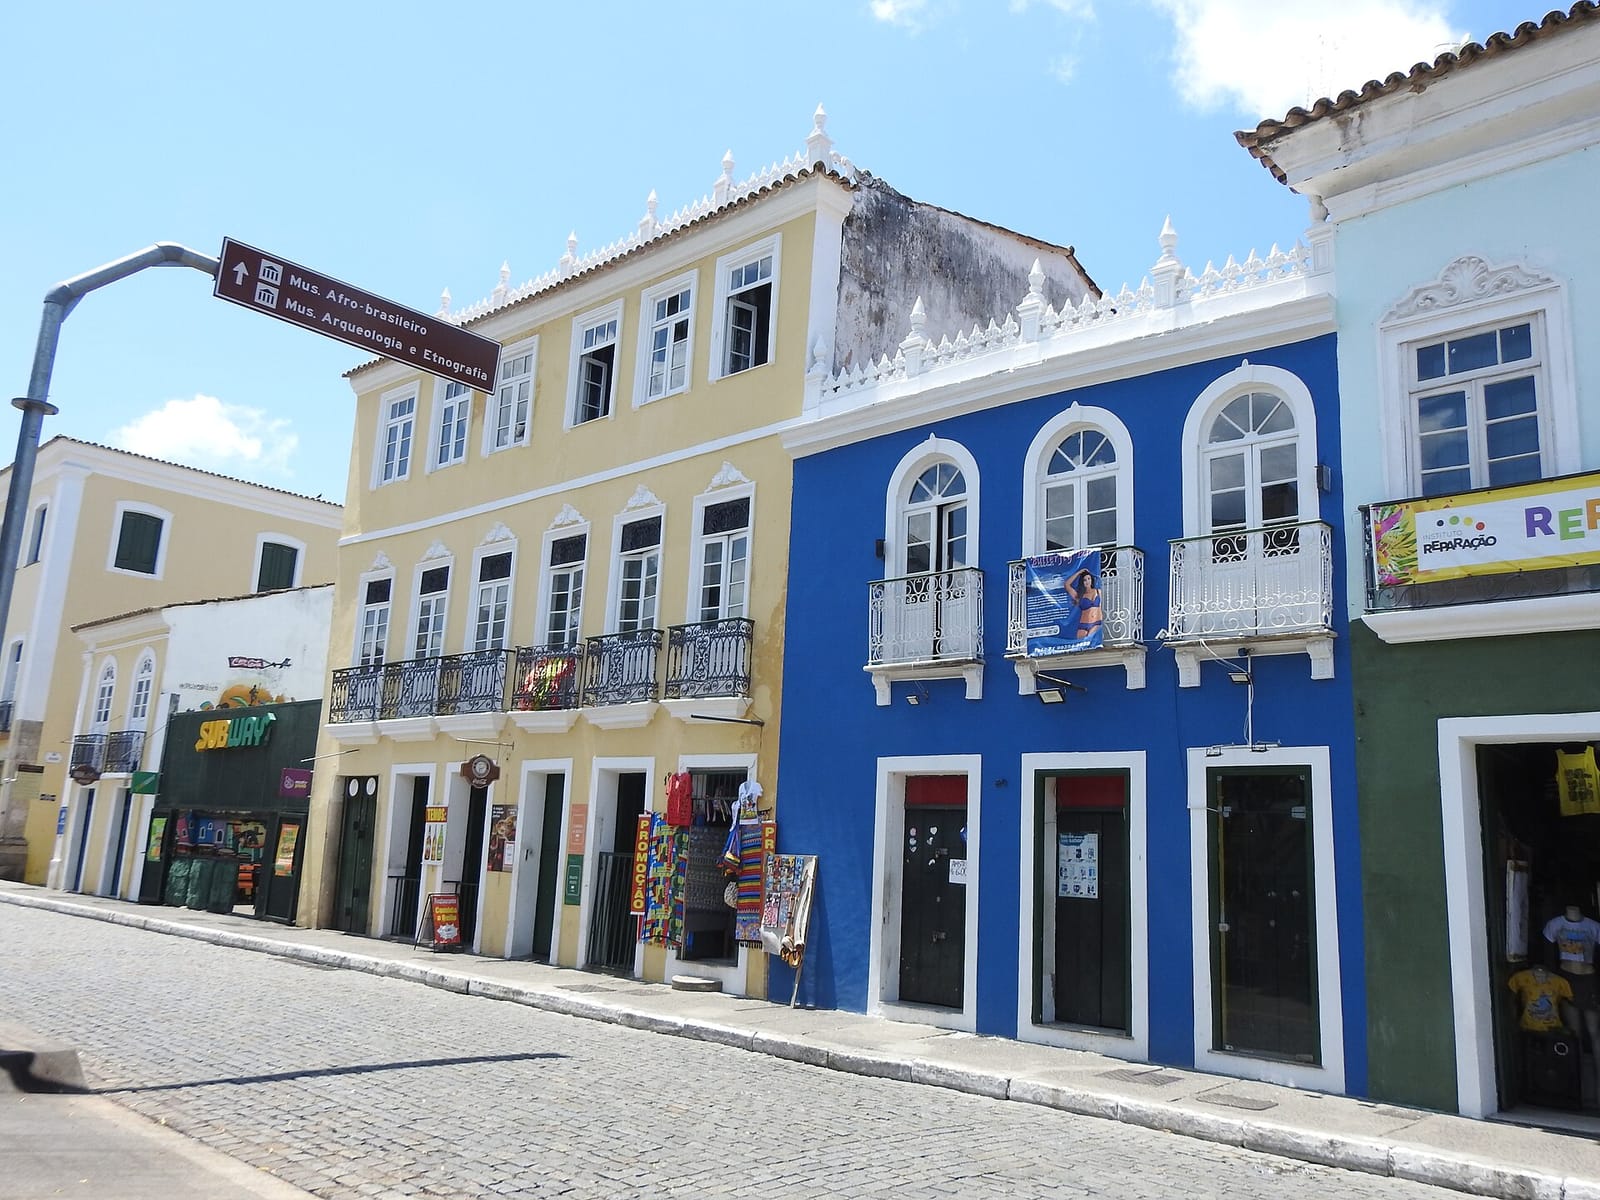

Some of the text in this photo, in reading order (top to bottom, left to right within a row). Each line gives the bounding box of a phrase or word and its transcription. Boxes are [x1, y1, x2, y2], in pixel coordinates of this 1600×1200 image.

[289, 275, 427, 335] Mus. Afro-brasileiro
[285, 298, 488, 382] Mus. Arqueologia e Etnografia
[1423, 530, 1463, 540] INSTITUTO
[1423, 534, 1497, 554] REPARAÇÃO
[195, 713, 276, 752] SUBWAY
[764, 826, 775, 855] PR
[633, 820, 650, 909] PROMOÇÃO
